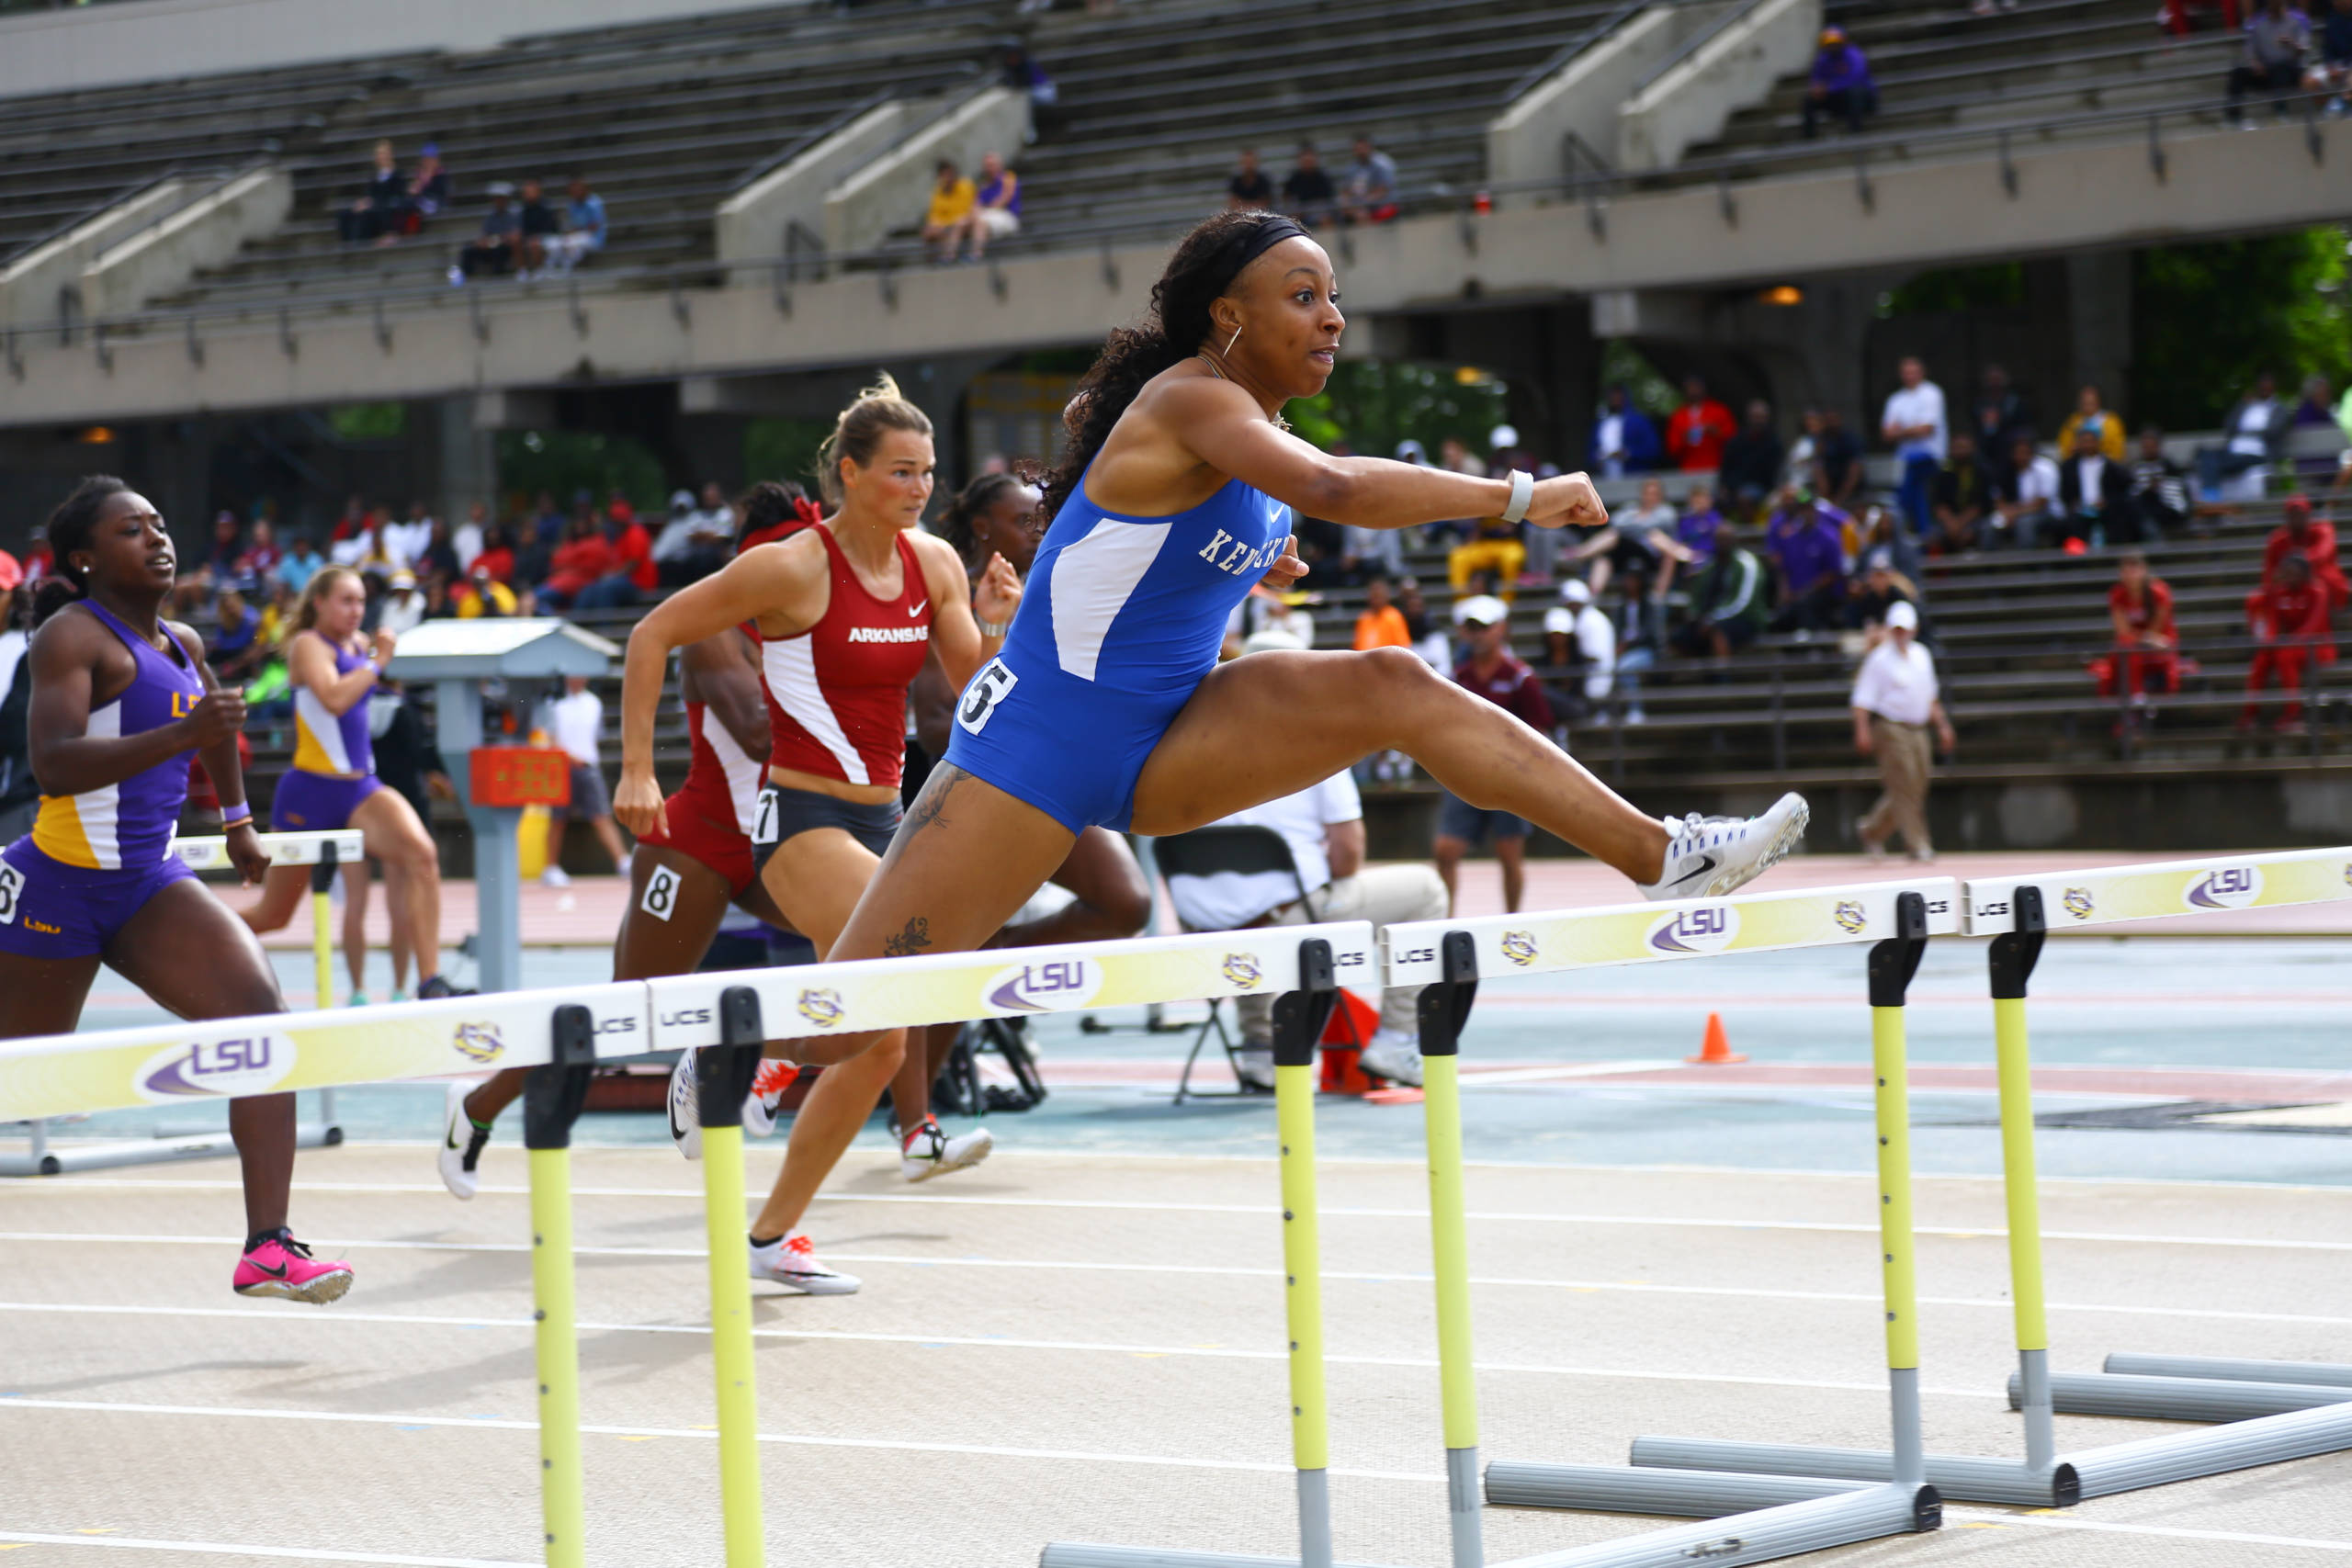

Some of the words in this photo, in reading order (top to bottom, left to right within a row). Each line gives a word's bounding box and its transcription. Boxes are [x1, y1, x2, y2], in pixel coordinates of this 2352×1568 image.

[848, 625, 928, 643] ARKANSAS
[961, 664, 1008, 724] 5
[759, 793, 773, 840] 7
[0, 868, 16, 915] 6
[648, 874, 672, 911] 8
[2211, 867, 2251, 894] LSU
[1679, 908, 1725, 936] LSU
[1976, 902, 2008, 917] UCS
[1396, 948, 1434, 964] UCS
[1023, 961, 1082, 992] LSU
[660, 1009, 711, 1027] UCS
[191, 1037, 270, 1076] LSU
